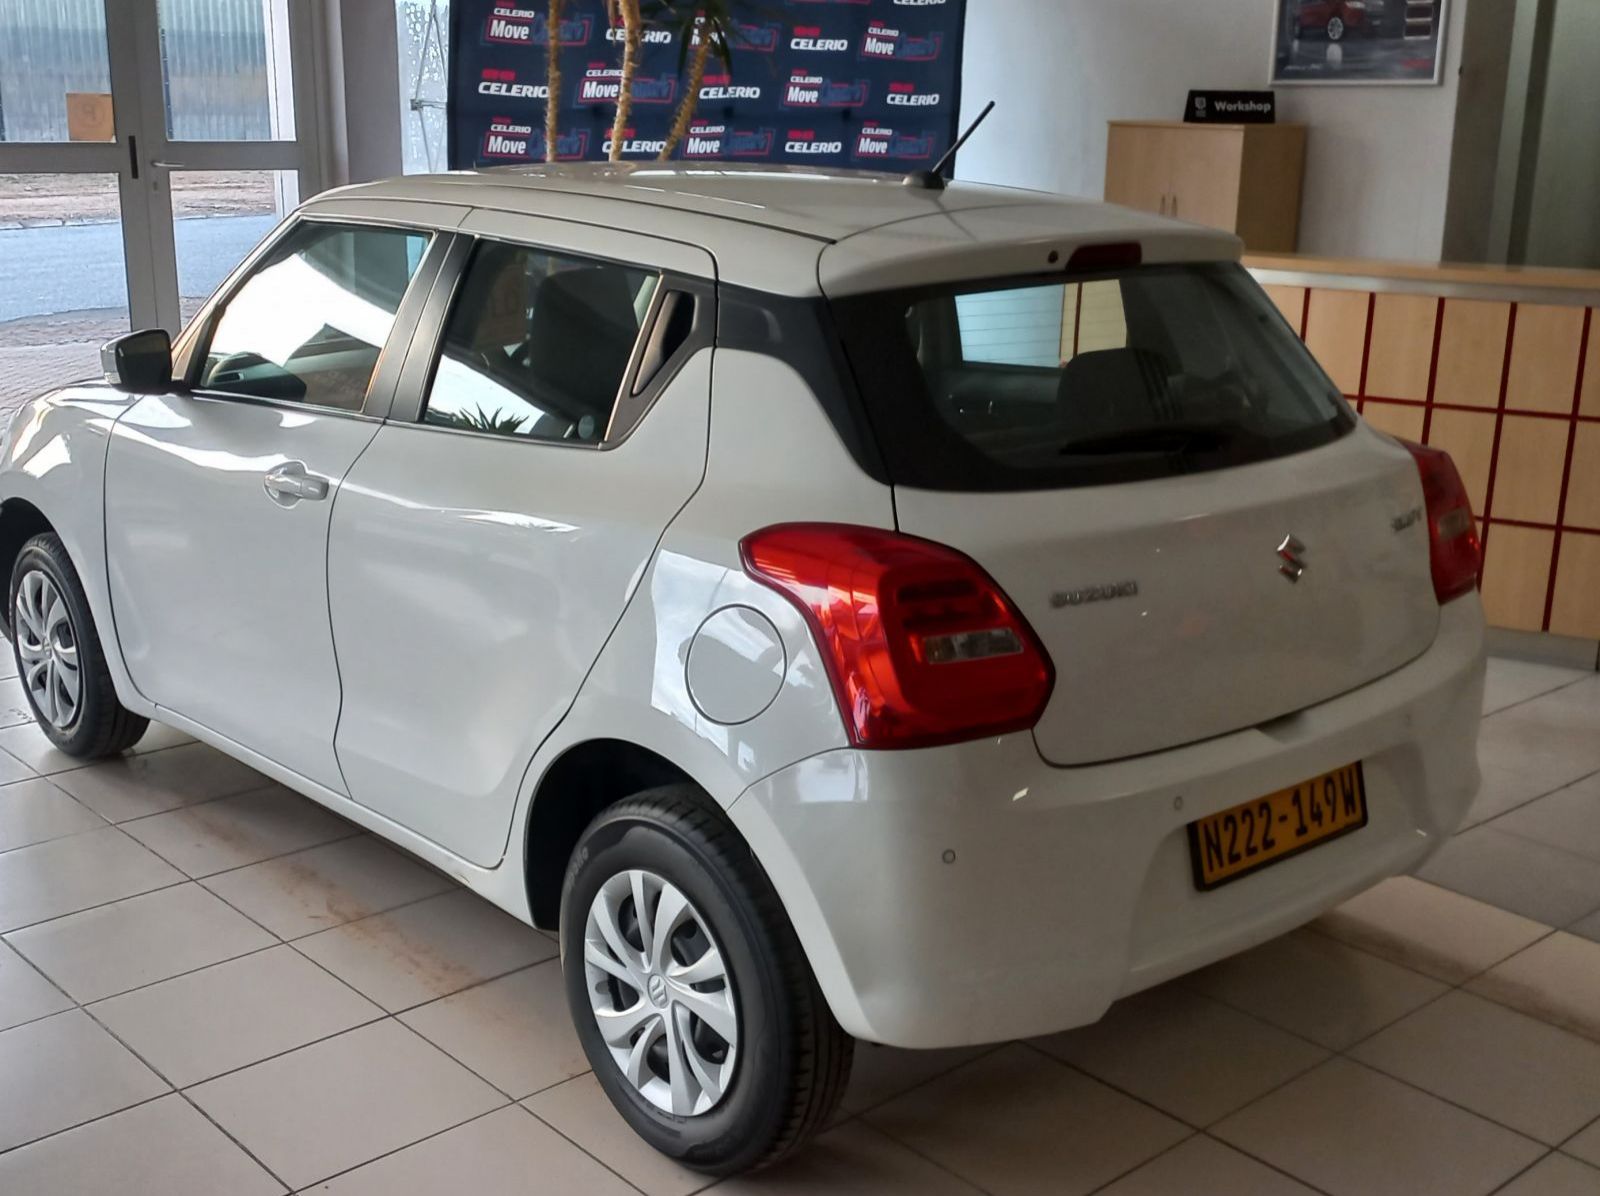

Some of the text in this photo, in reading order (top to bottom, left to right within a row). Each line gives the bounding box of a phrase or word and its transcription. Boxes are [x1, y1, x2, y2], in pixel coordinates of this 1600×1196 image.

[493, 7, 535, 18] CELERIO
[490, 18, 531, 40] Move
[605, 27, 672, 44] CERIO
[868, 26, 899, 37] CELERIO
[790, 37, 848, 51] CELERIO
[864, 37, 895, 56] Move
[790, 75, 823, 84] CELERIO
[478, 81, 549, 98] CELERIO
[582, 81, 619, 99] Move
[698, 86, 761, 100] CELERIO
[786, 85, 819, 103] Move
[886, 93, 940, 106] CELERIO
[1213, 100, 1272, 114] Workshop
[490, 123, 532, 134] CELERIO
[689, 125, 725, 134] CELERIO
[861, 127, 893, 136] CELERIO
[487, 135, 527, 155] Move
[601, 140, 667, 153] CLERIO
[686, 137, 721, 154] Move
[784, 141, 842, 154] CELERIO
[858, 137, 888, 154] Move
[1203, 771, 1357, 873] N222-149W
